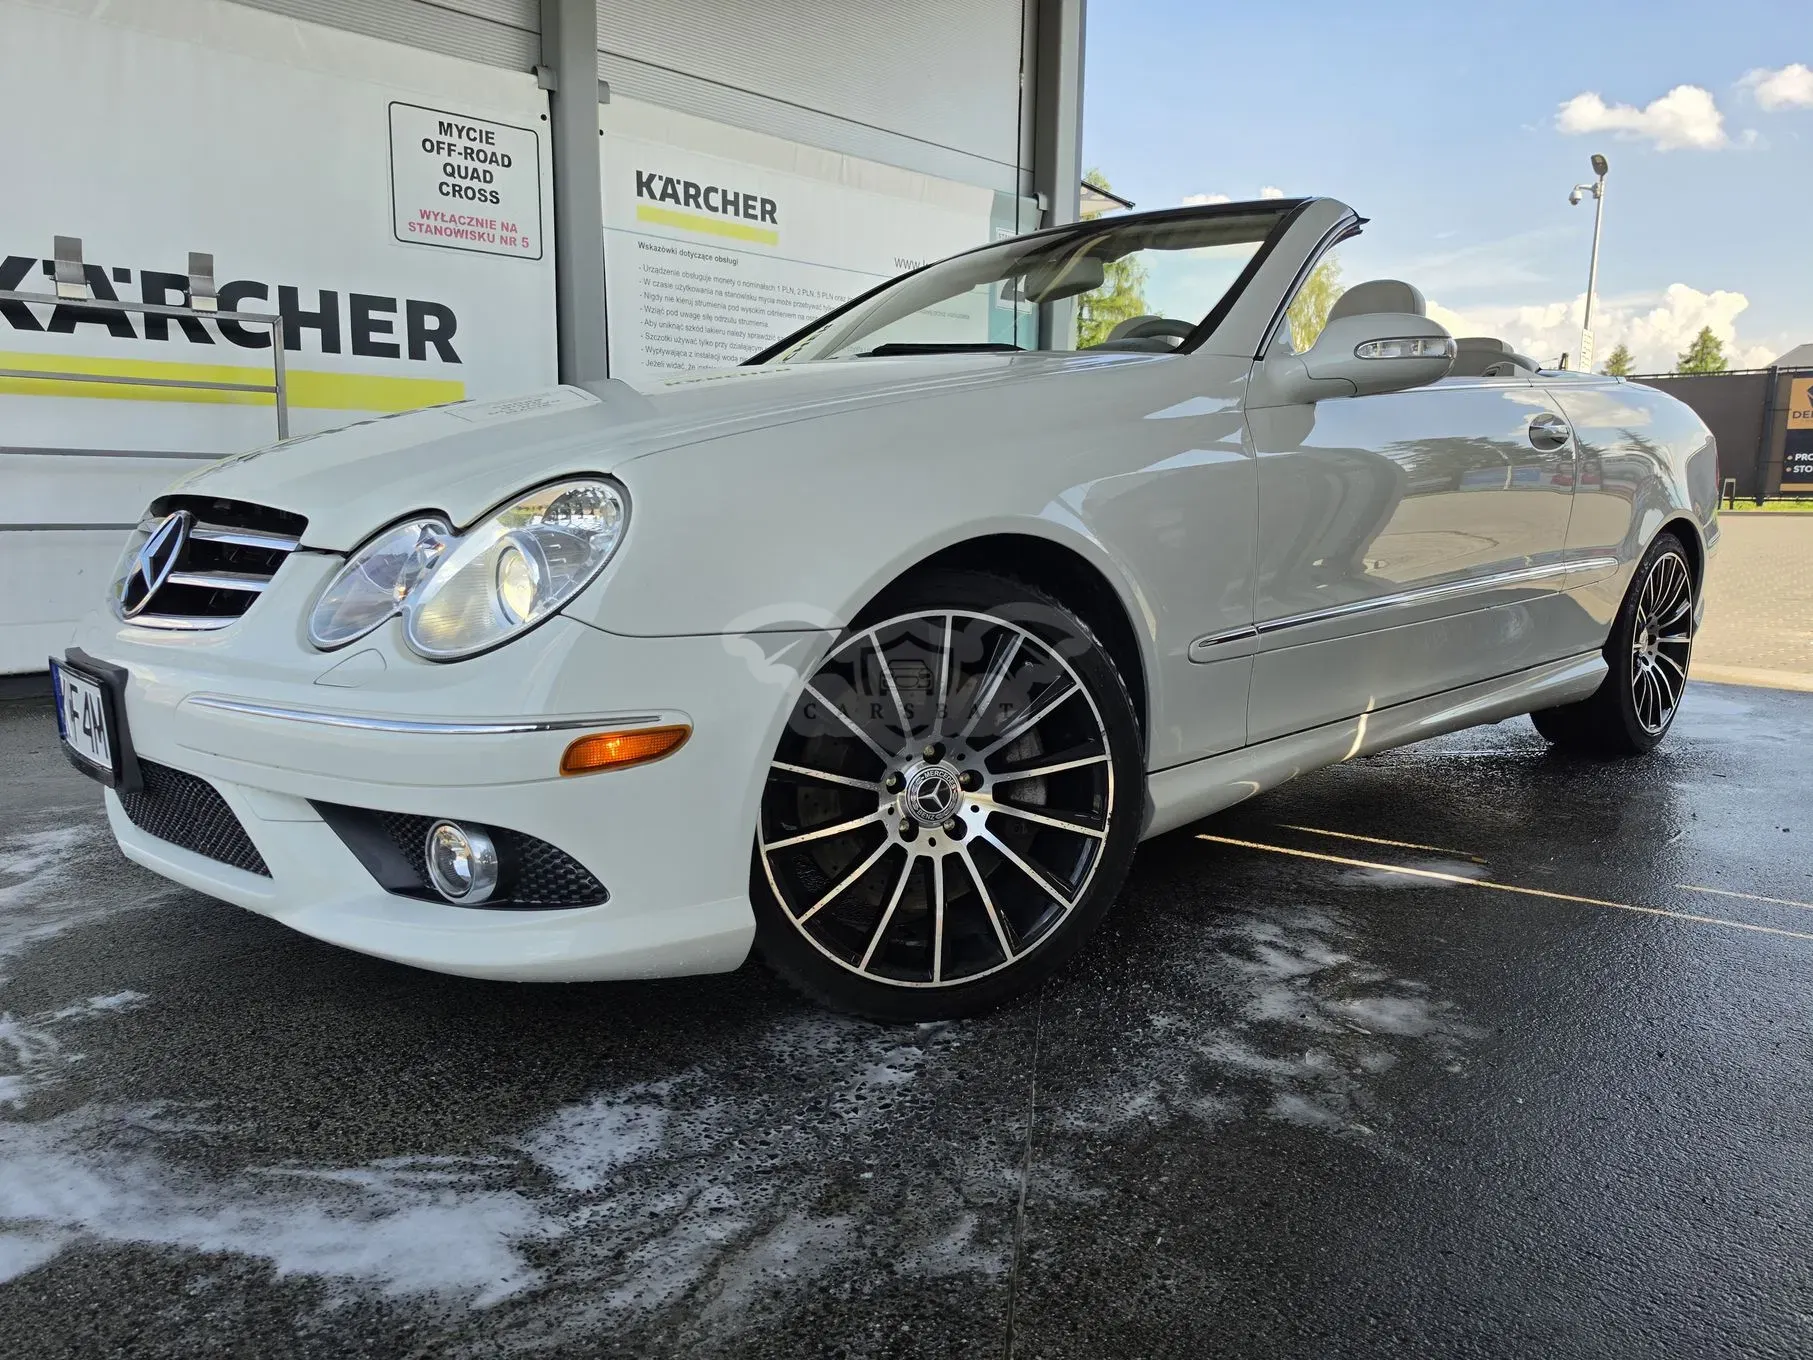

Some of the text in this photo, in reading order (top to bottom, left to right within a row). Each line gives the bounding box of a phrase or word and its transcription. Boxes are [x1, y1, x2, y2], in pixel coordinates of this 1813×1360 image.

[438, 120, 496, 146] MYCIE
[421, 138, 512, 168] OFF-ROAD
[442, 162, 494, 184] QUAD
[438, 181, 501, 205] CROSS
[635, 169, 778, 225] KÄRCHER
[419, 208, 518, 234] WYŁĄCZNIE NA
[408, 221, 530, 248] STANOWISKU NR 5
